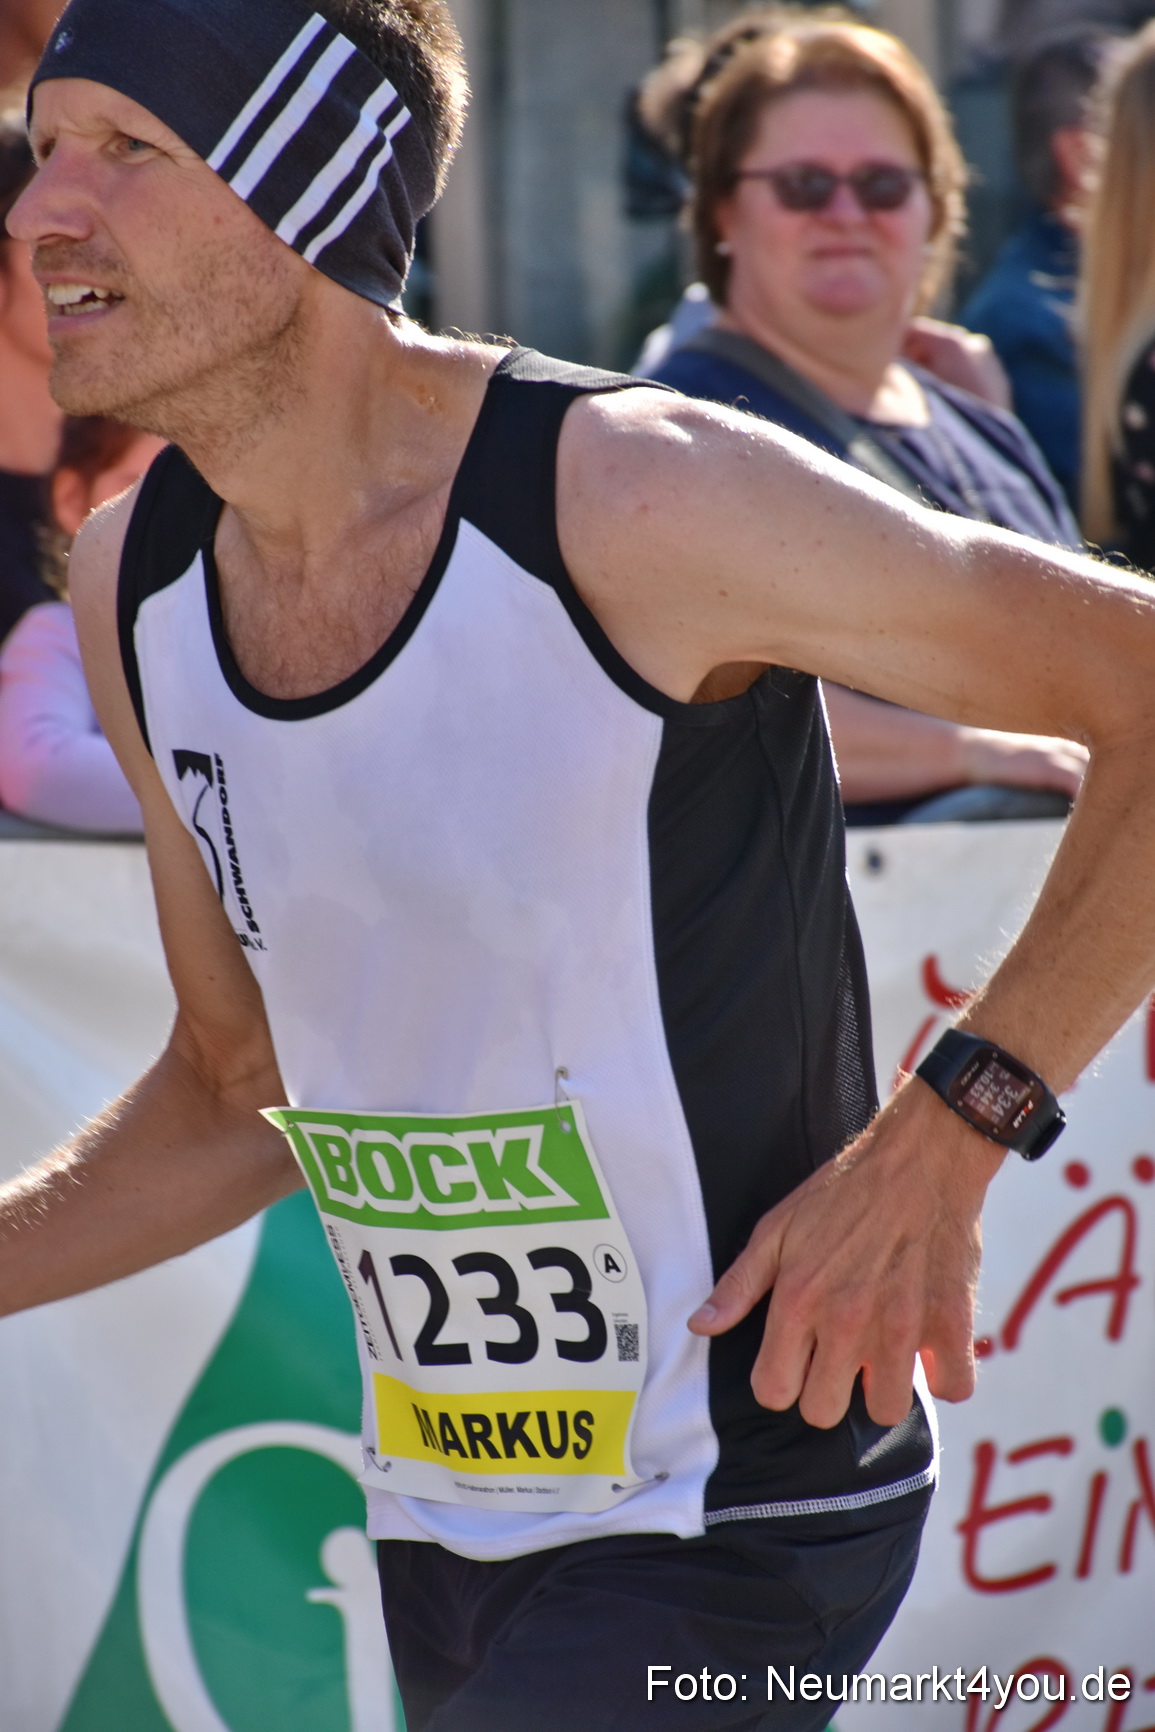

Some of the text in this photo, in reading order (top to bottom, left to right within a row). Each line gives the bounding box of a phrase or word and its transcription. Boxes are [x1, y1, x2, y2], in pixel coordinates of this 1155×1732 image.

[214, 752, 260, 934] SCHWANDORF
[302, 1127, 566, 1209] BOCK
[604, 1253, 622, 1274] A
[358, 1246, 608, 1367] 1233
[411, 1402, 595, 1460] MARKUS
